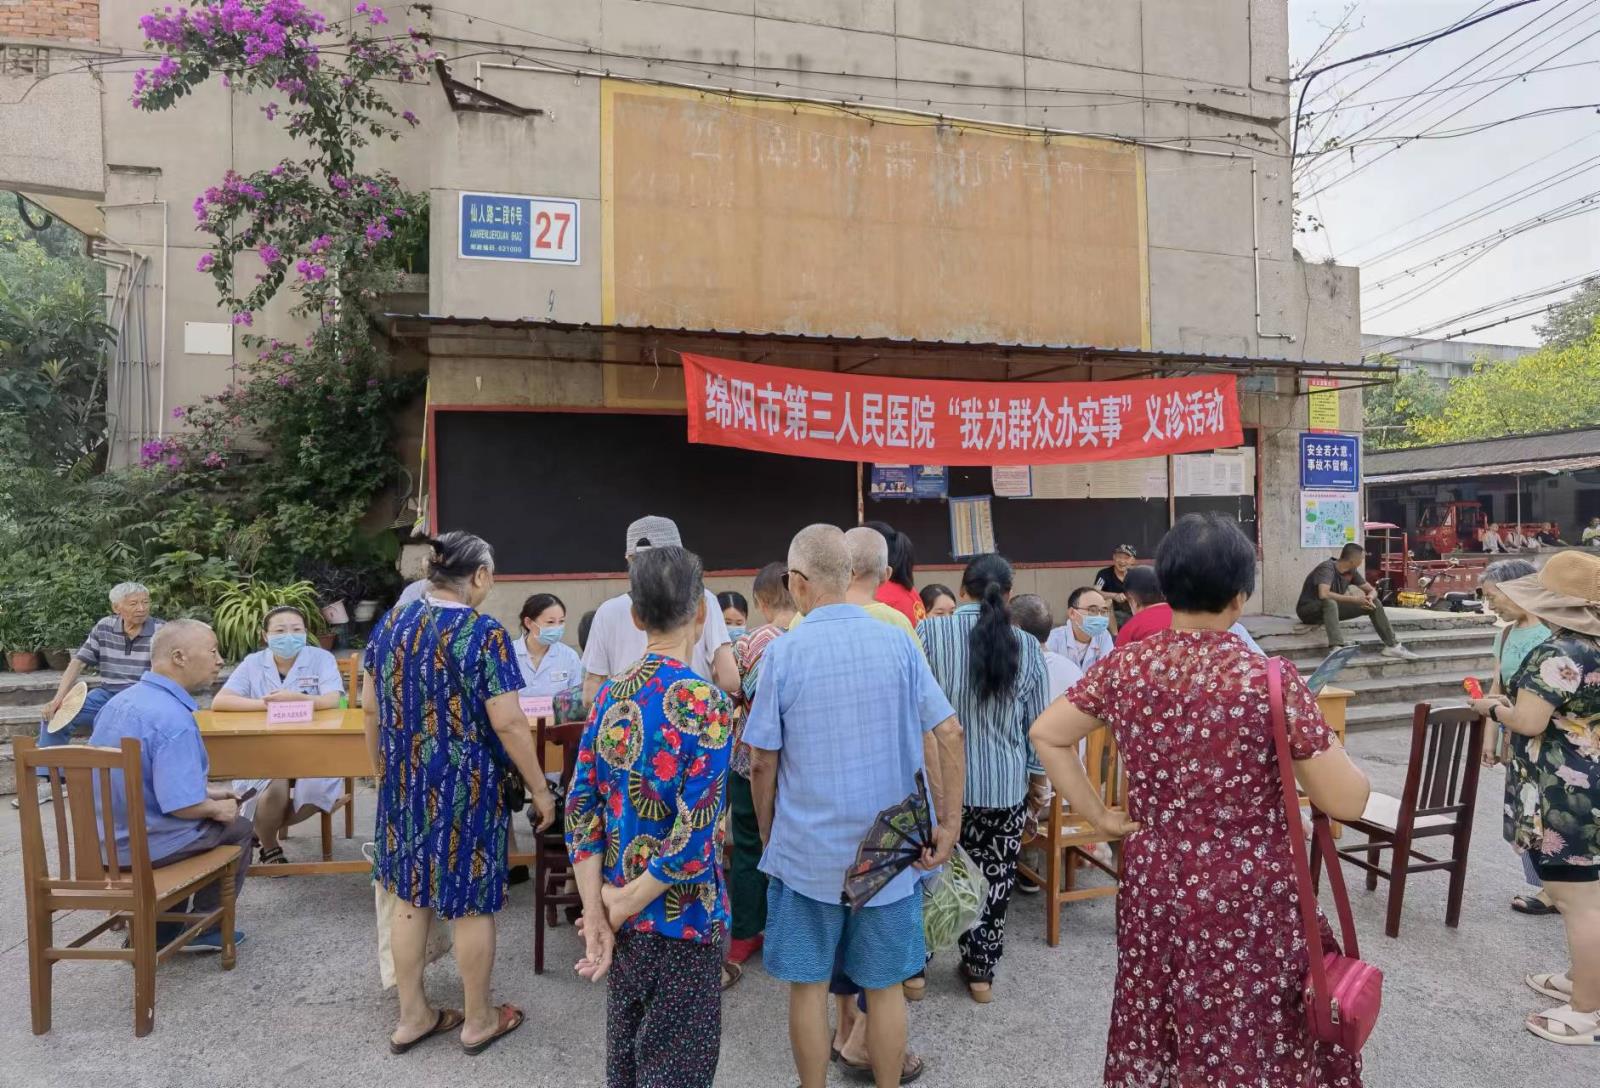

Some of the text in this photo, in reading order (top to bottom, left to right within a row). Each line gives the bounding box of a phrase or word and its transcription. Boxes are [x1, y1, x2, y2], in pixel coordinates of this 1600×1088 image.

[470, 203, 523, 226] 仙人路二段6号
[535, 211, 571, 250] 27
